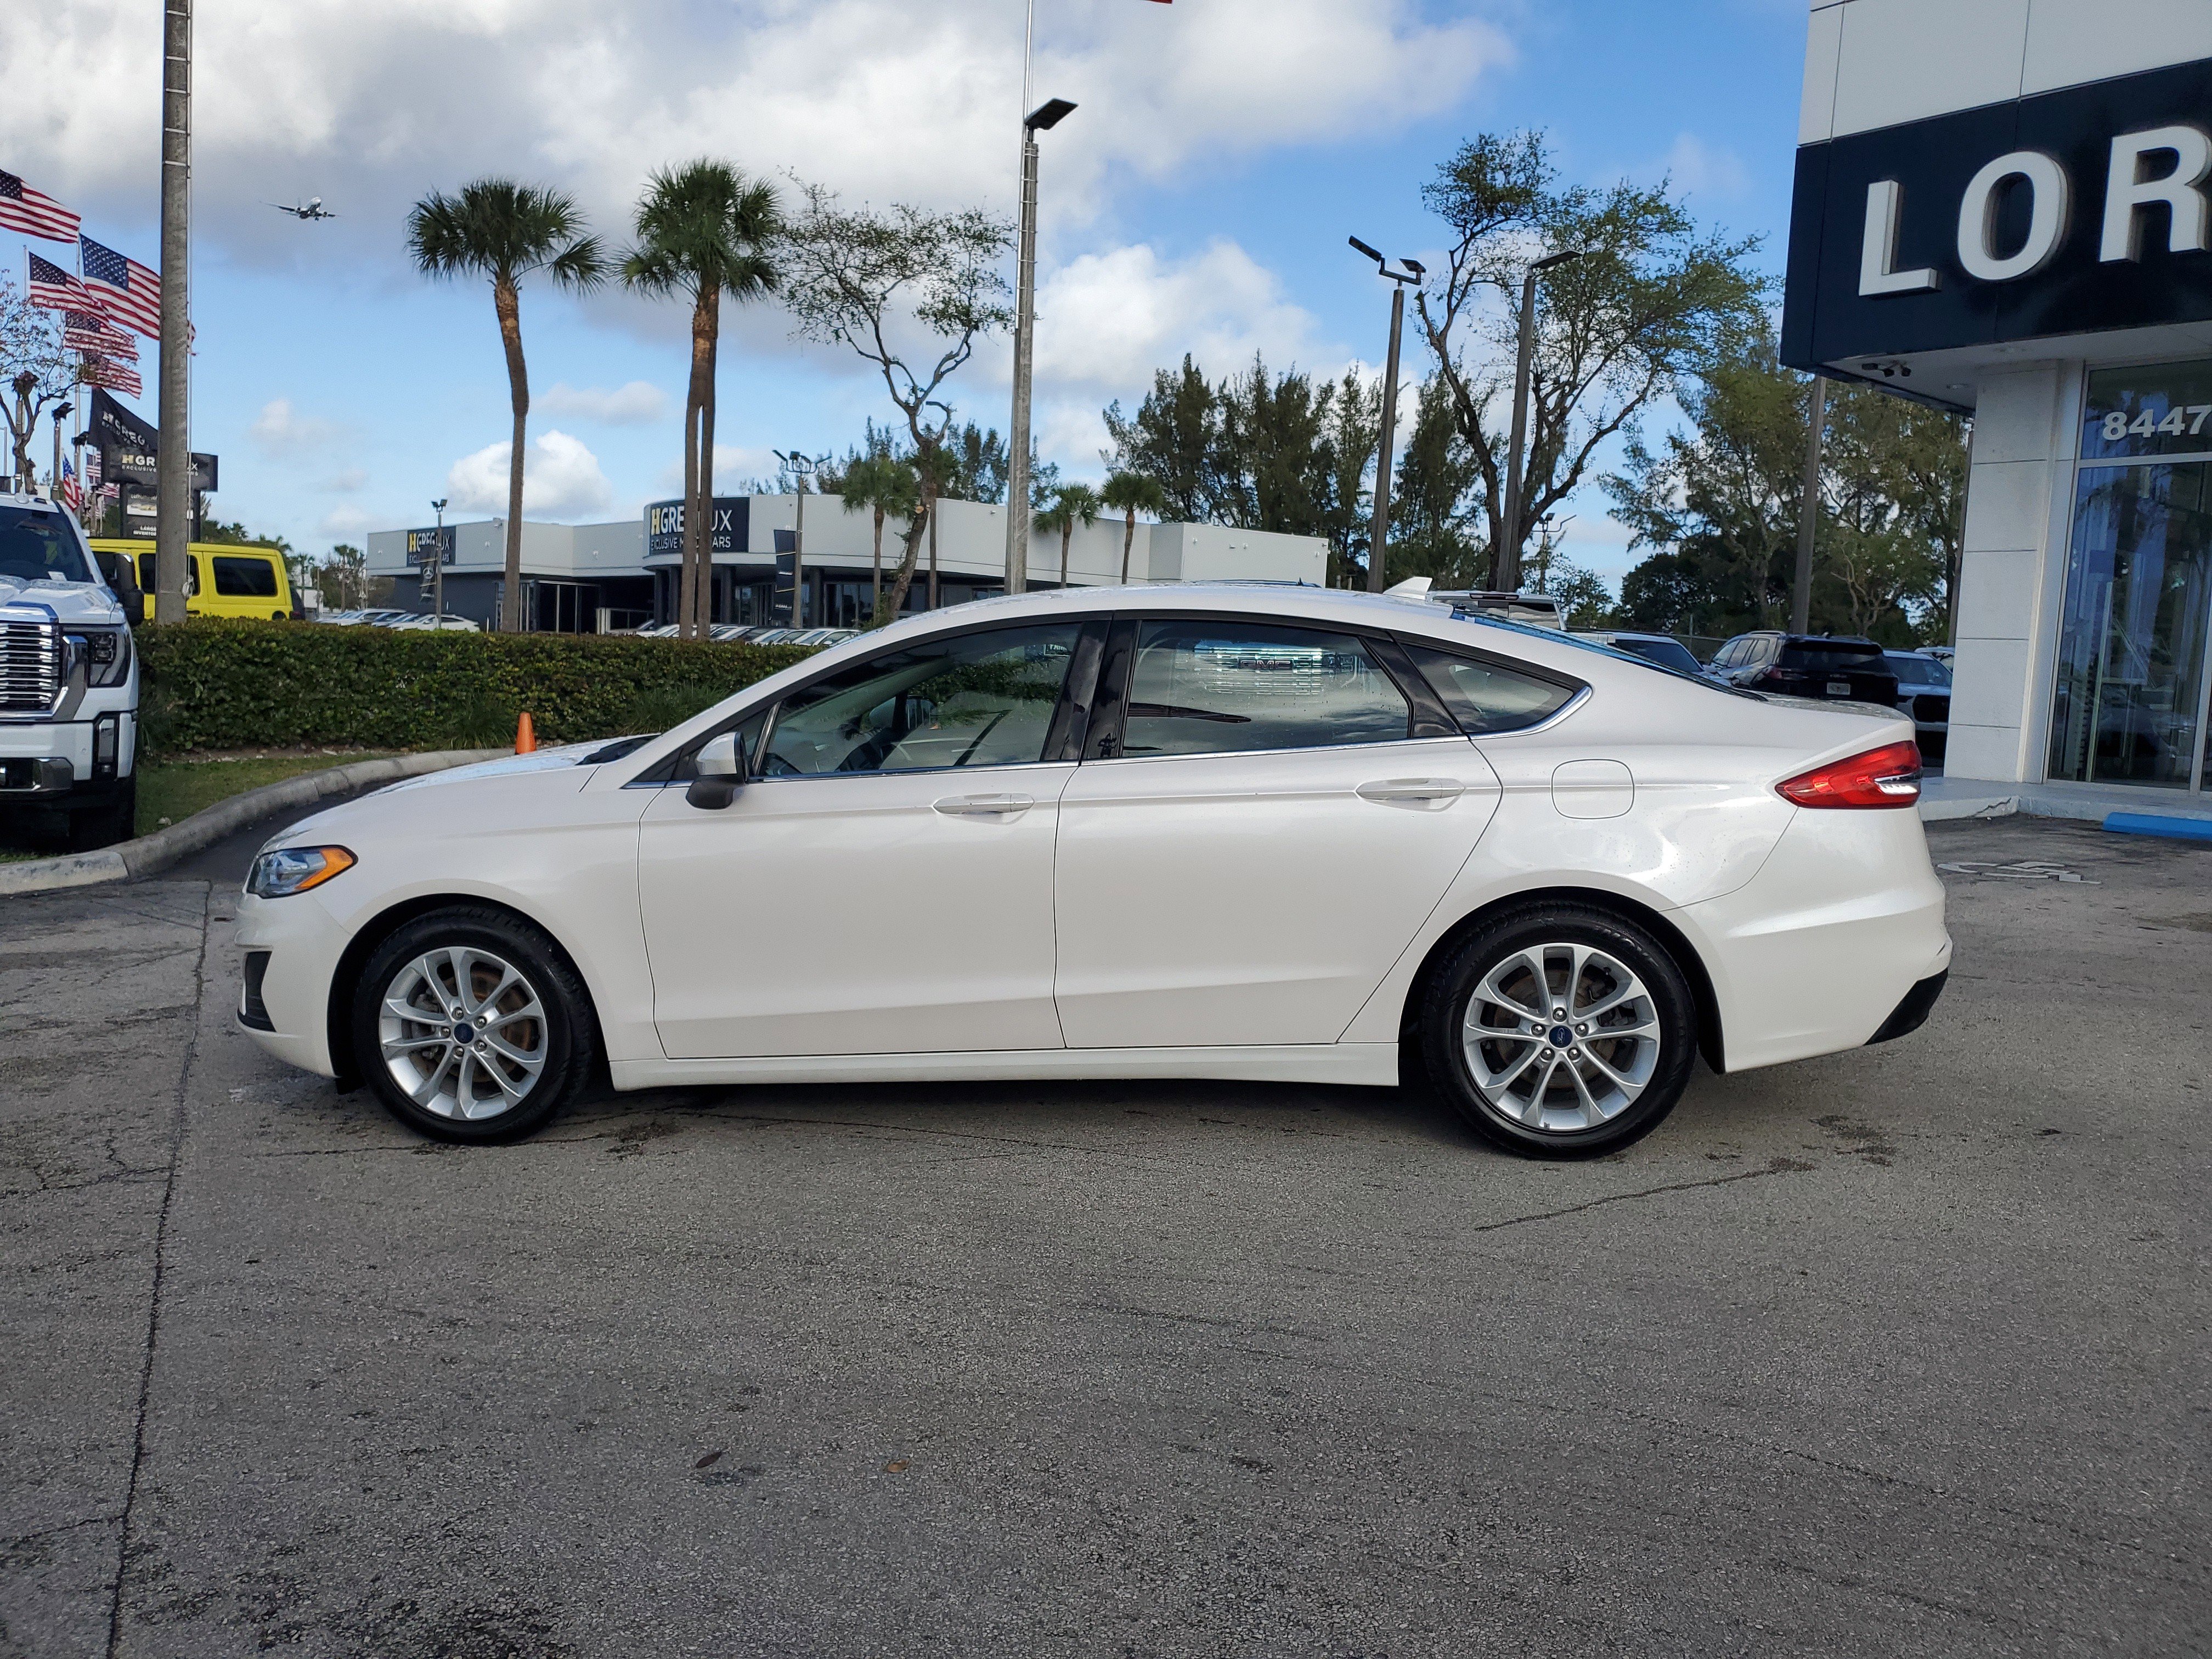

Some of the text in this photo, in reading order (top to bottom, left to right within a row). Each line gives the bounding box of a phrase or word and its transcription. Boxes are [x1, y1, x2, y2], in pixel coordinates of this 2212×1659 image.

[1859, 125, 2212, 296] LOR
[2103, 404, 2212, 441] 8447
[1240, 660, 1291, 669] GMC
